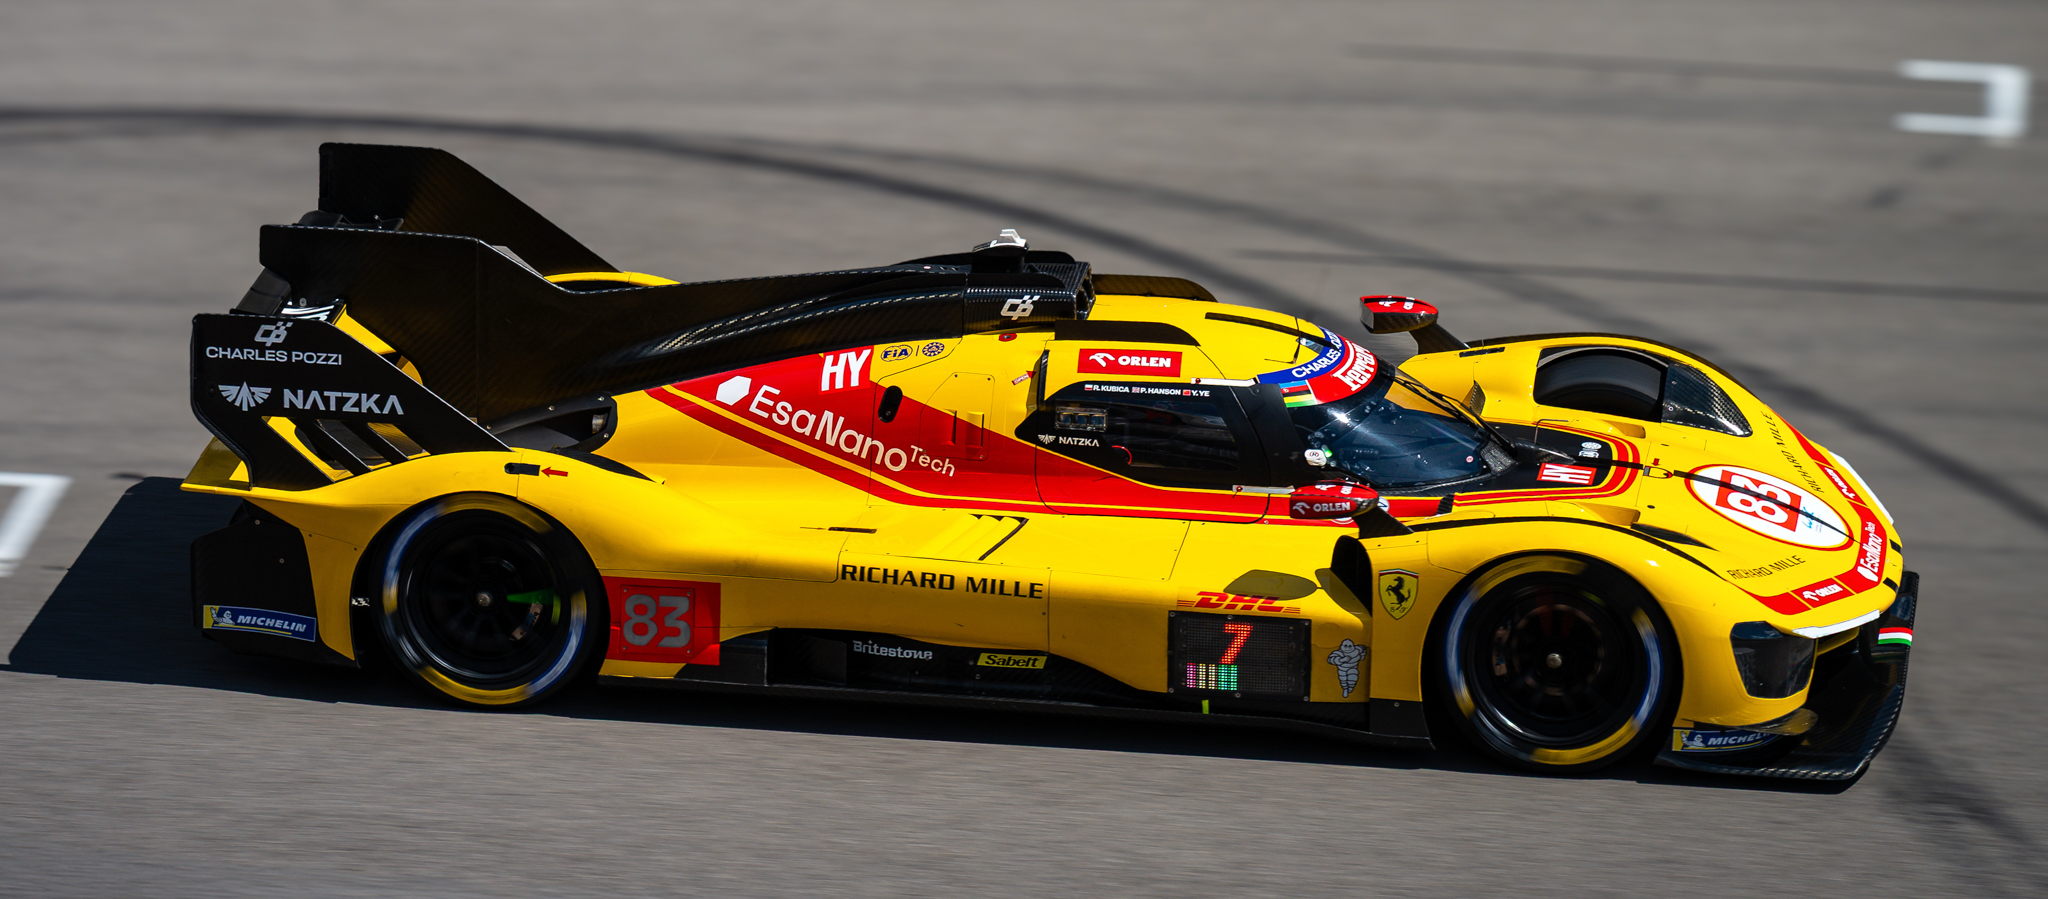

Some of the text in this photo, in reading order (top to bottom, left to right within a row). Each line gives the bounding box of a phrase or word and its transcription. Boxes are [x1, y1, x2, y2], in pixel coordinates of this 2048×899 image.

[206, 346, 342, 365] CHARLES POZZI
[1118, 355, 1171, 368] ORLEN
[821, 348, 872, 392] HY
[283, 388, 404, 415] NATZKA
[1058, 435, 1100, 448] NATZKA
[1313, 501, 1351, 512] ORLEN
[1726, 555, 1806, 580] RICHARD MILLE
[841, 564, 1044, 599] RICHARD MILLE
[1194, 591, 1285, 613] DHL
[237, 615, 307, 632] MICHELIN
[623, 593, 691, 648] 83
[852, 640, 933, 660] Britestone
[984, 654, 1040, 668] Sabelt
